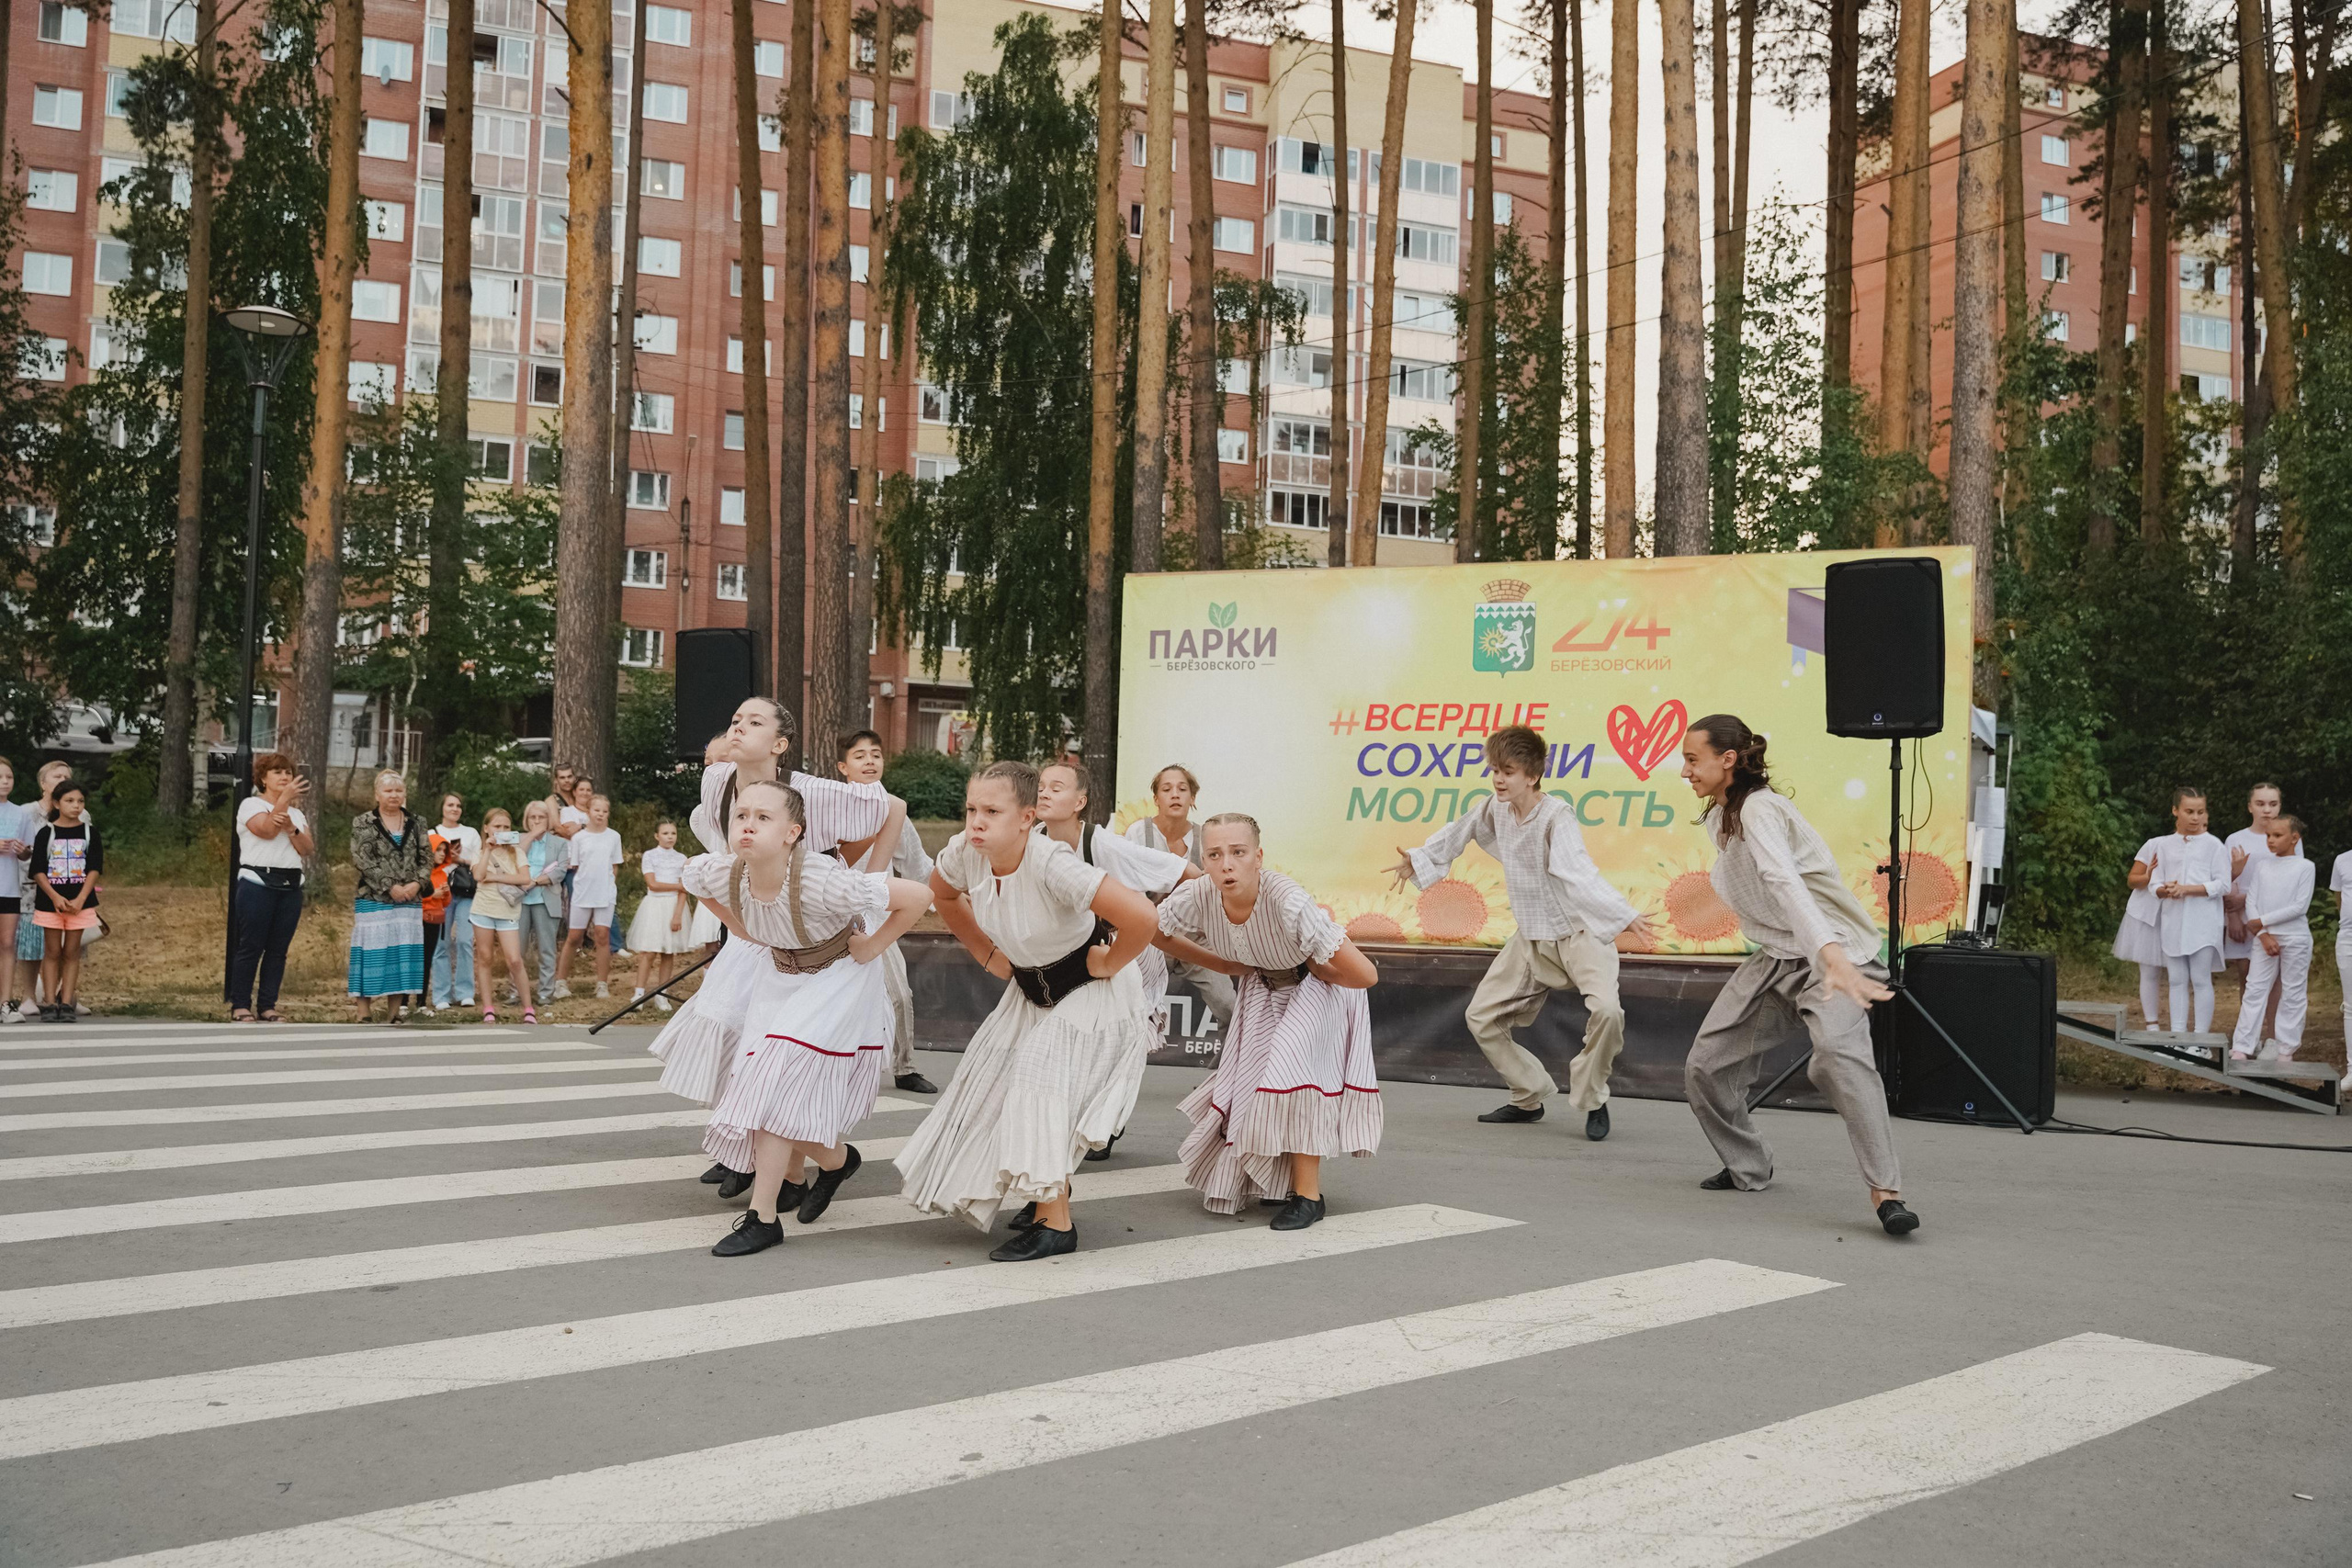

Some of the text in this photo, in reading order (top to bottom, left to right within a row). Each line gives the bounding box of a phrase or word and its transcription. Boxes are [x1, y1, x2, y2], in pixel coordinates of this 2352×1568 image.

[1149, 627, 1277, 660] ПАРКИ
[1167, 660, 1256, 671] БЕРЁЗОВСКОГО
[1551, 656, 1671, 671] БЕРЁЗОВСКИЙ
[1329, 703, 1549, 738] #ВСЕРДЦЕ
[1357, 743, 1595, 779] СОХРИ
